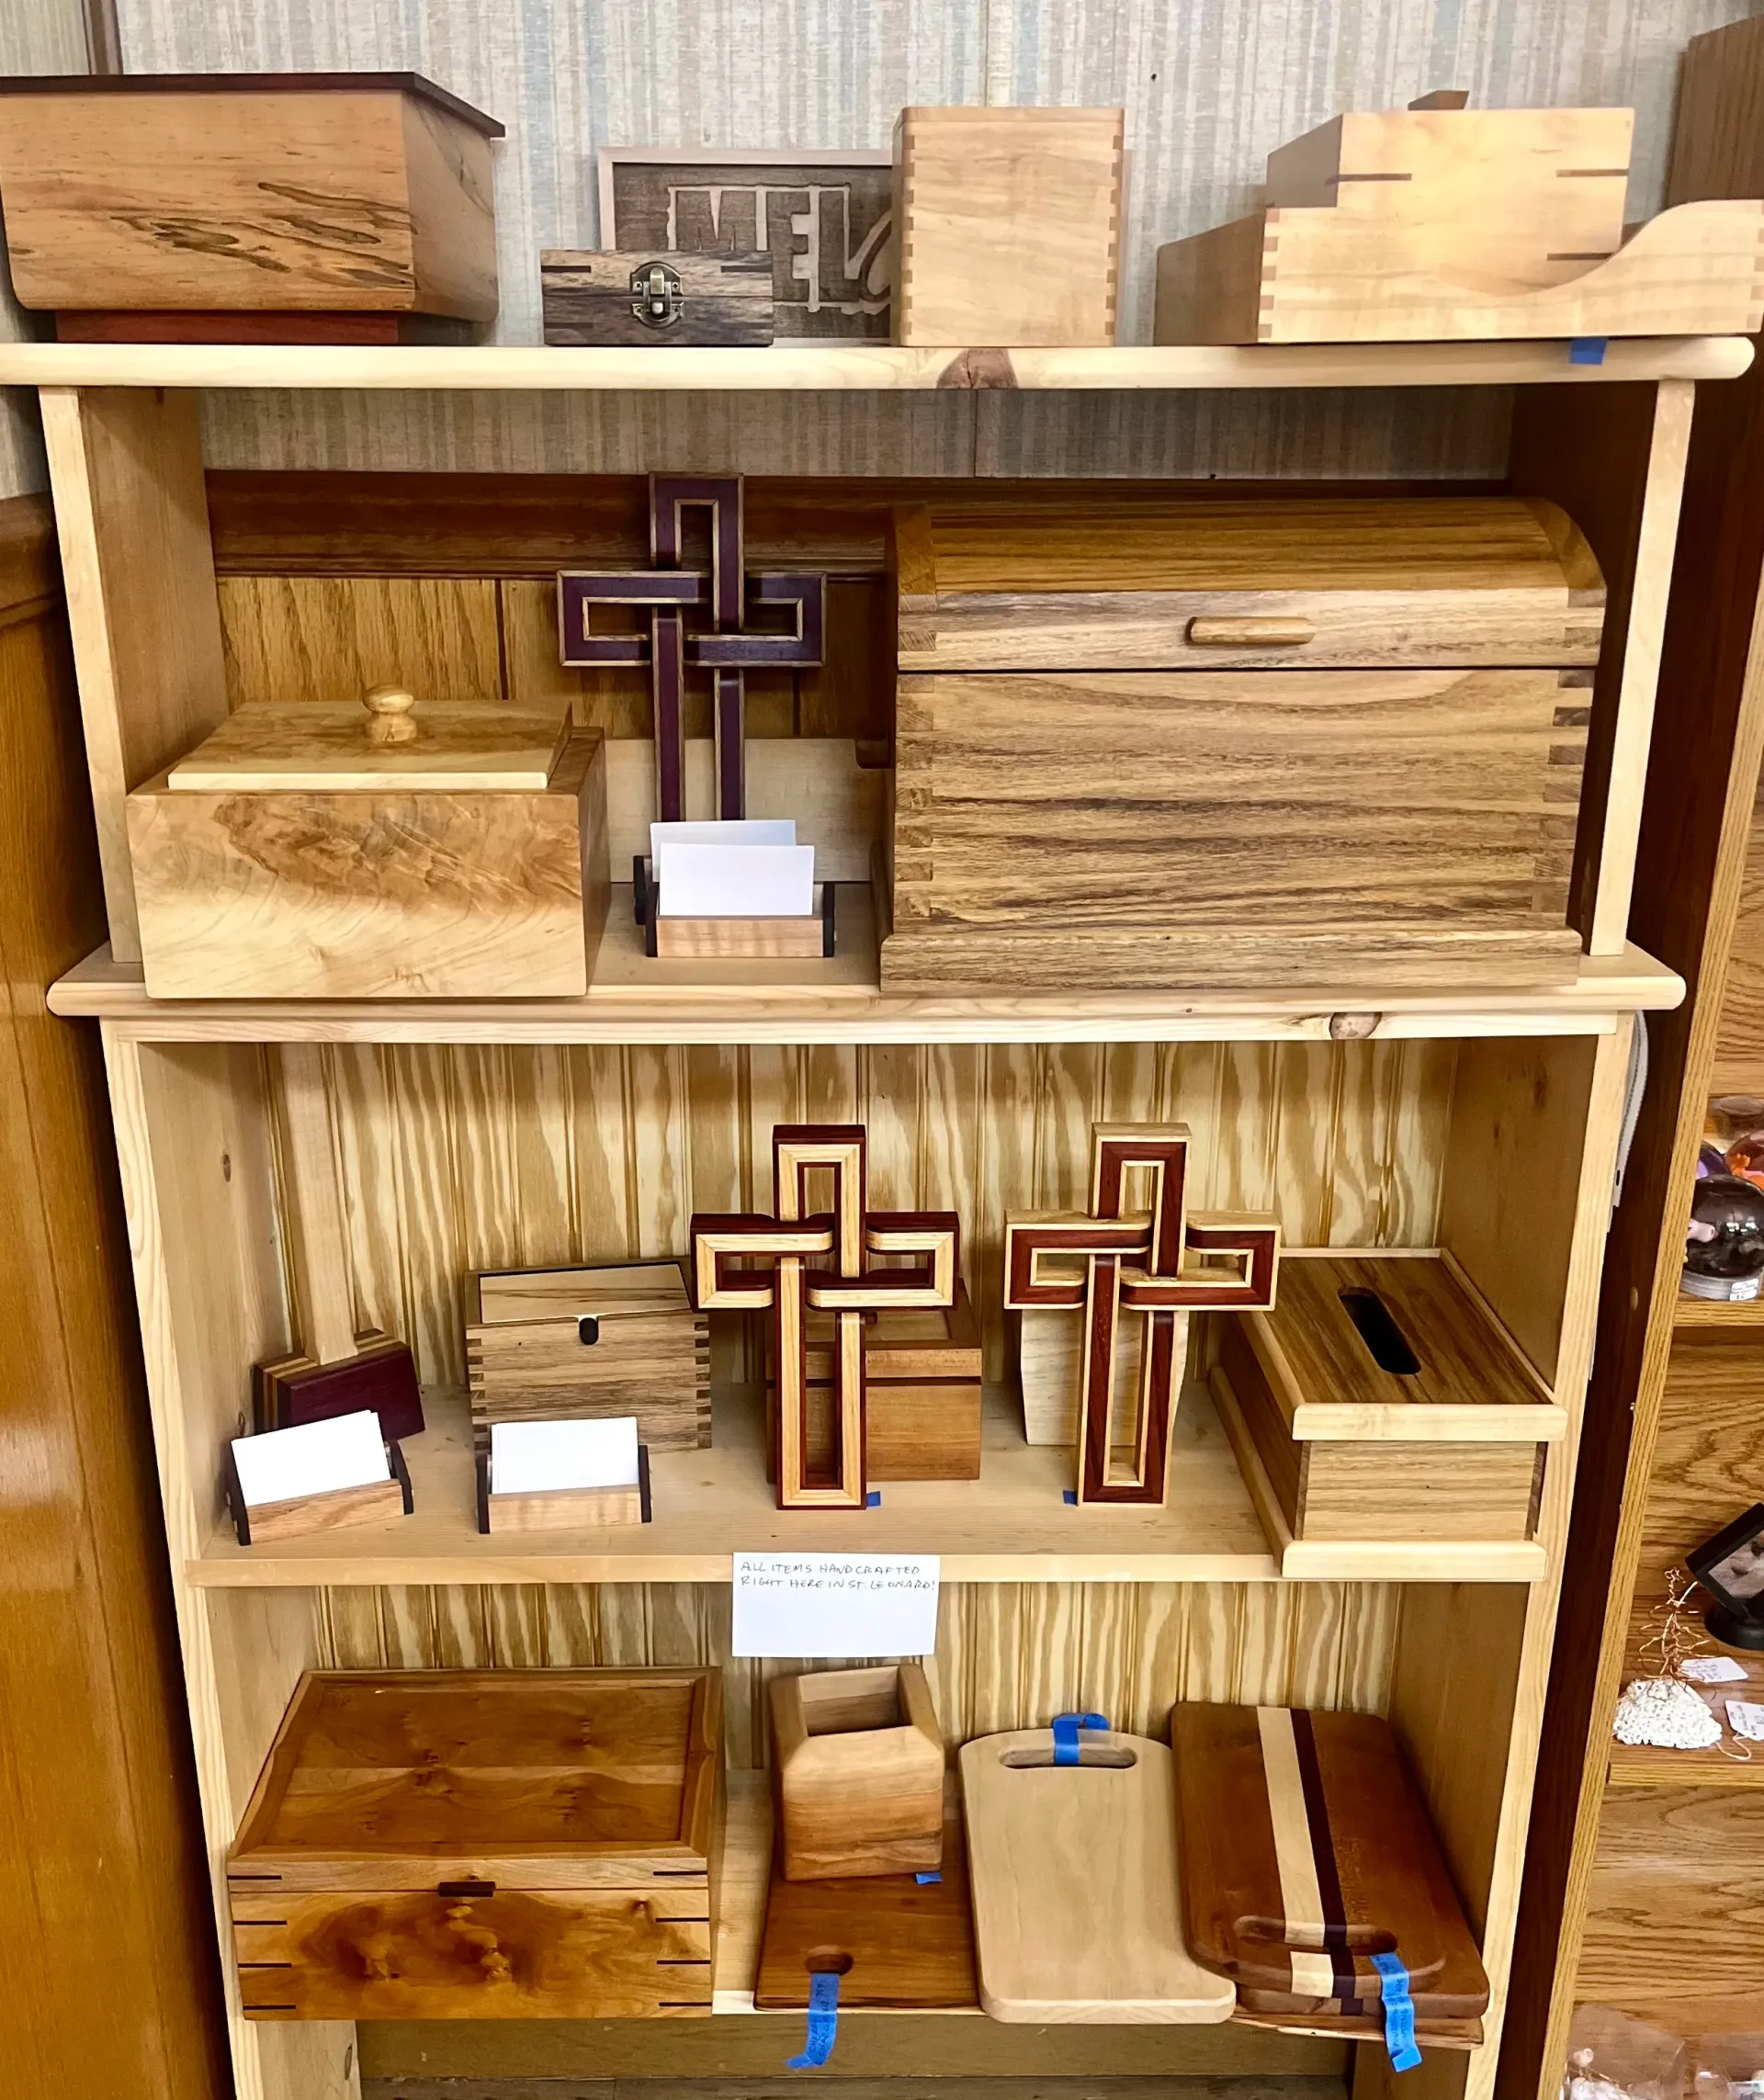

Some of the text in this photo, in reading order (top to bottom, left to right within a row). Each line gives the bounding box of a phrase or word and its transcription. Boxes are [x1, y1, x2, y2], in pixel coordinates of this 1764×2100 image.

[741, 1561, 766, 1573] ALL
[772, 1563, 813, 1574] ITEMS
[741, 1575, 784, 1586] RIGHT
[789, 1578, 824, 1588] HERE
[828, 1579, 844, 1588] IN
[870, 1579, 935, 1590] LEONARD!
